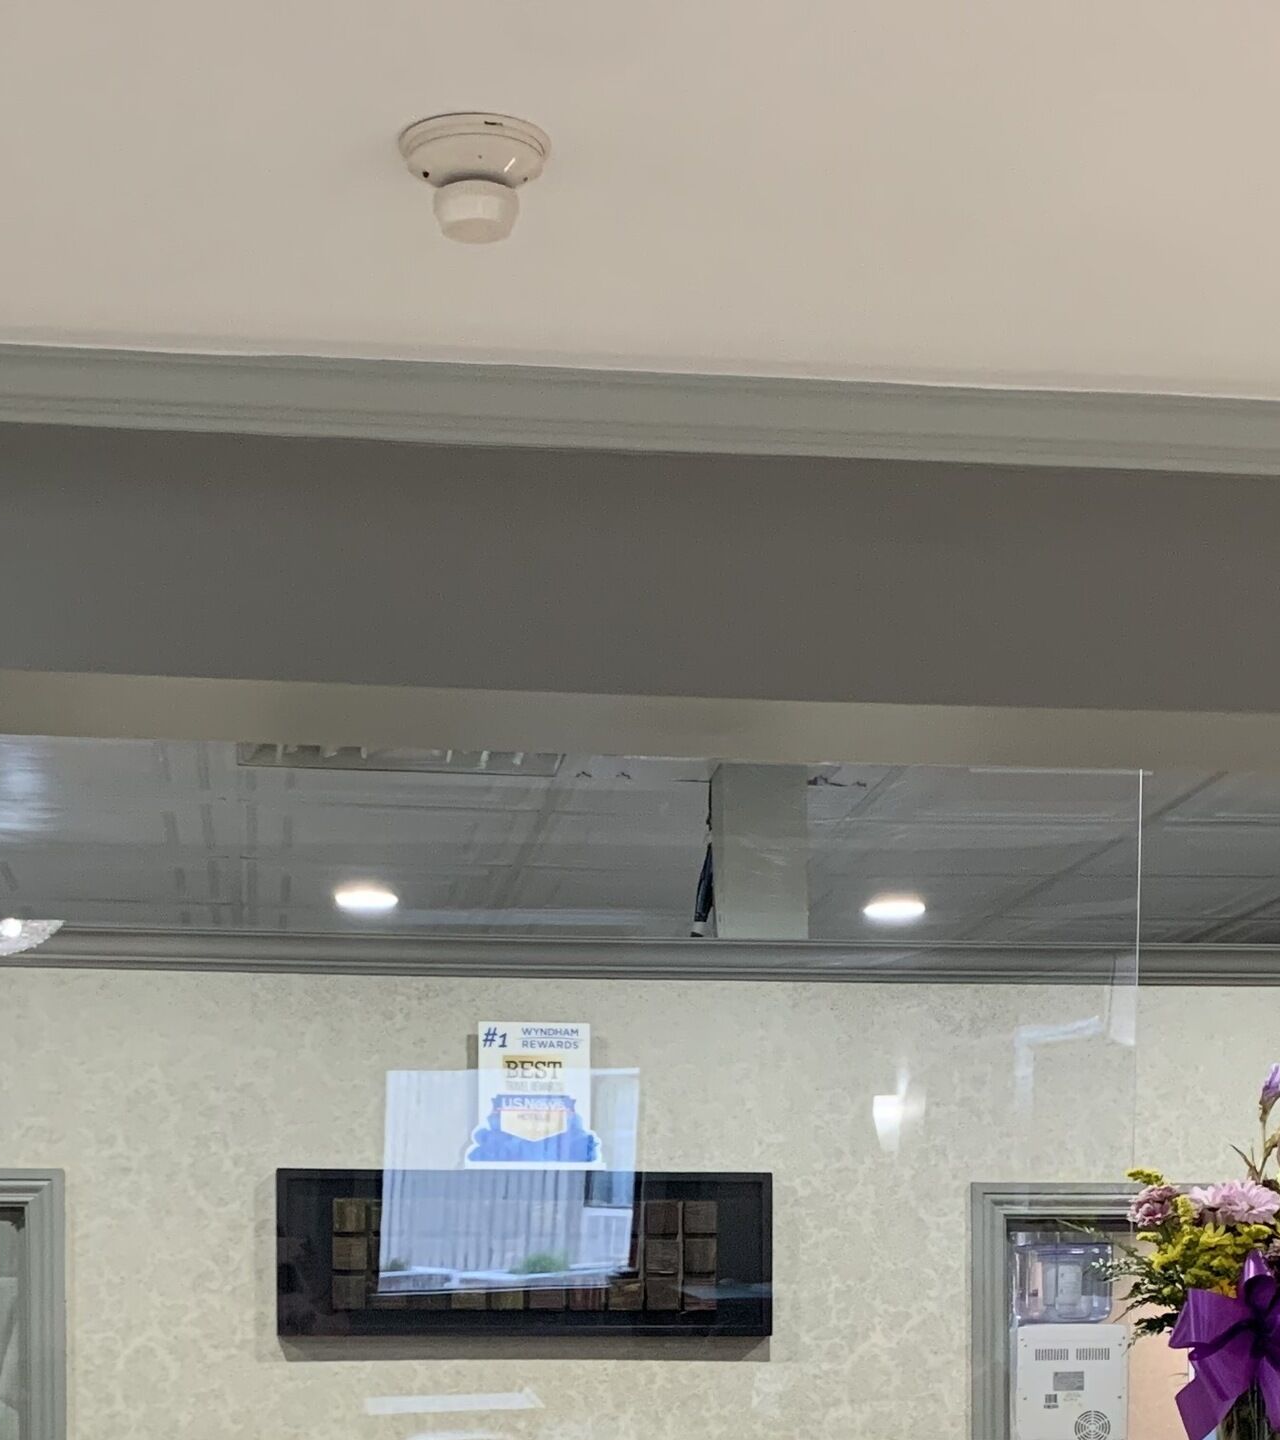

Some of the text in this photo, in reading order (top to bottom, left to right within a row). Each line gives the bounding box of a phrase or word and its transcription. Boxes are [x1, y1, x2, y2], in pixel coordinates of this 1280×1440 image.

[482, 1027, 508, 1048] #1
[521, 1027, 579, 1037] WYNDHAM
[522, 1040, 579, 1050] REWARDS
[505, 1060, 562, 1079] BEST
